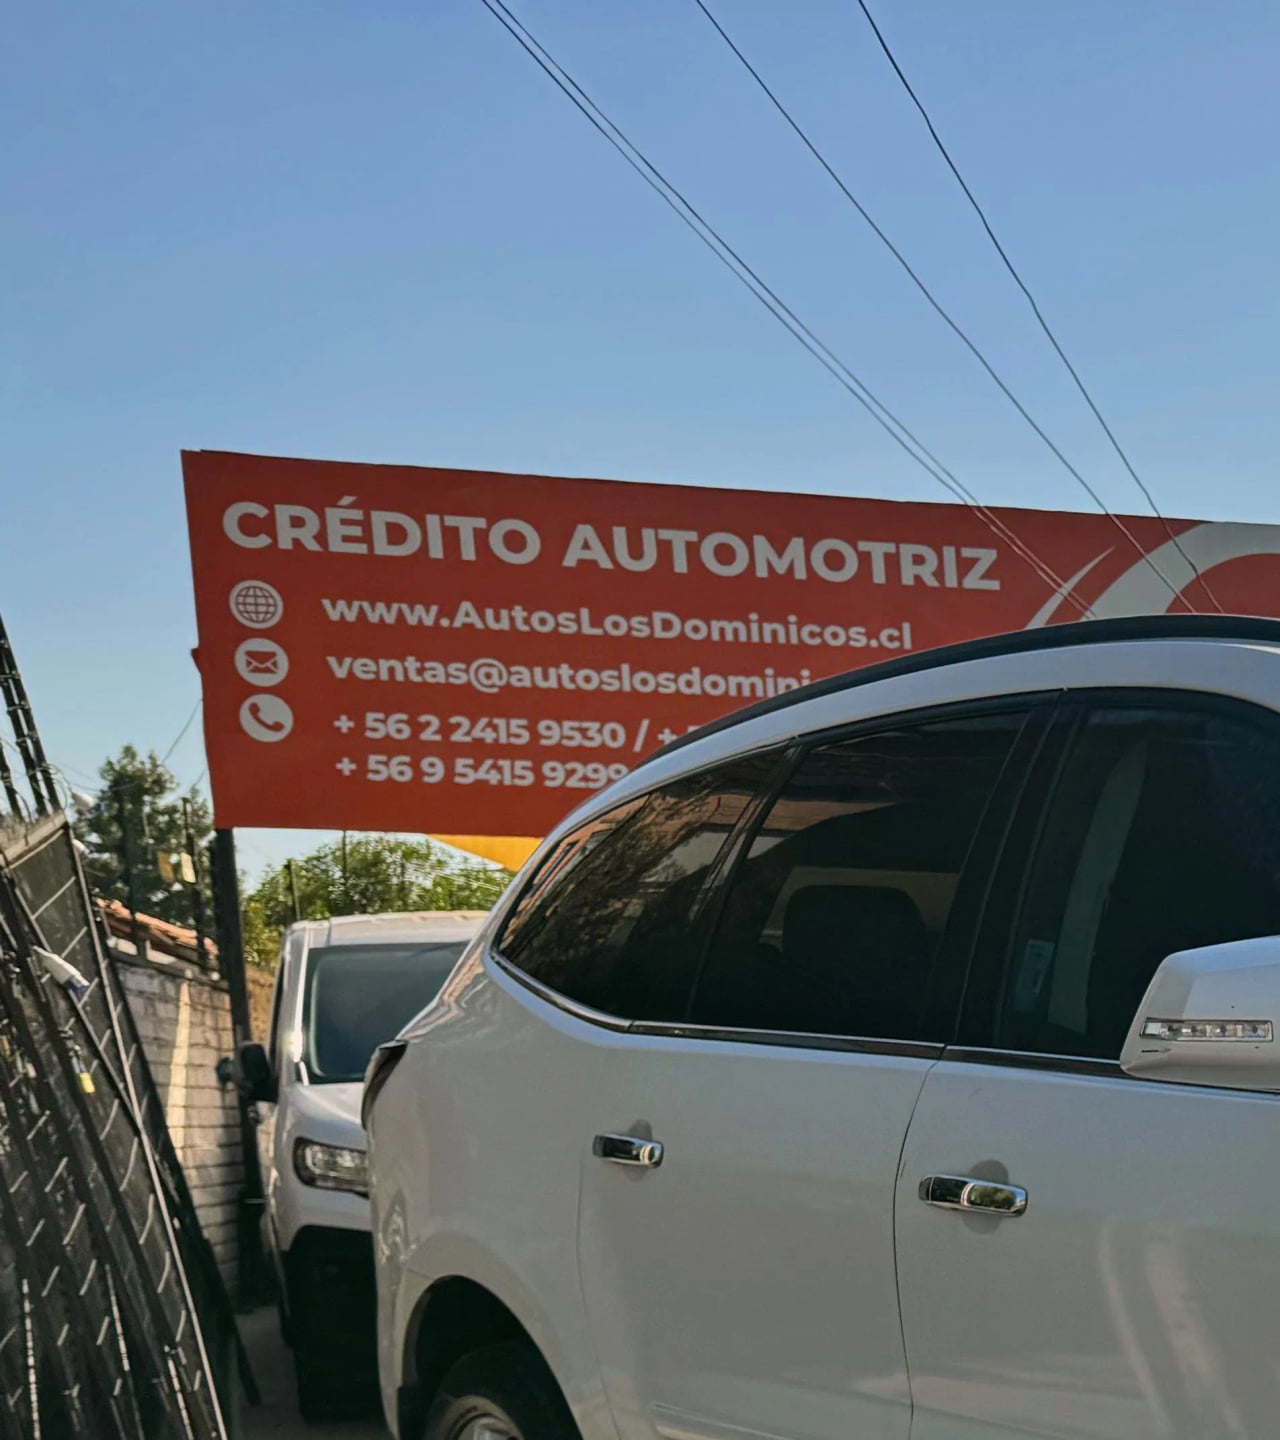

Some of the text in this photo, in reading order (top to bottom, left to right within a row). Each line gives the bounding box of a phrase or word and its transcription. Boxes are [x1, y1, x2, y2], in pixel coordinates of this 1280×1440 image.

[222, 496, 1001, 592] CRÉDITO AUTOMOTRIZ
[320, 598, 912, 650] www.AutosLosDominicos.cl
[364, 712, 411, 740] 56
[417, 715, 442, 741] 2
[448, 715, 530, 745] 2415
[536, 719, 627, 749] 9530
[366, 755, 413, 782] 56
[420, 757, 445, 783] 9
[453, 758, 535, 786] 5415
